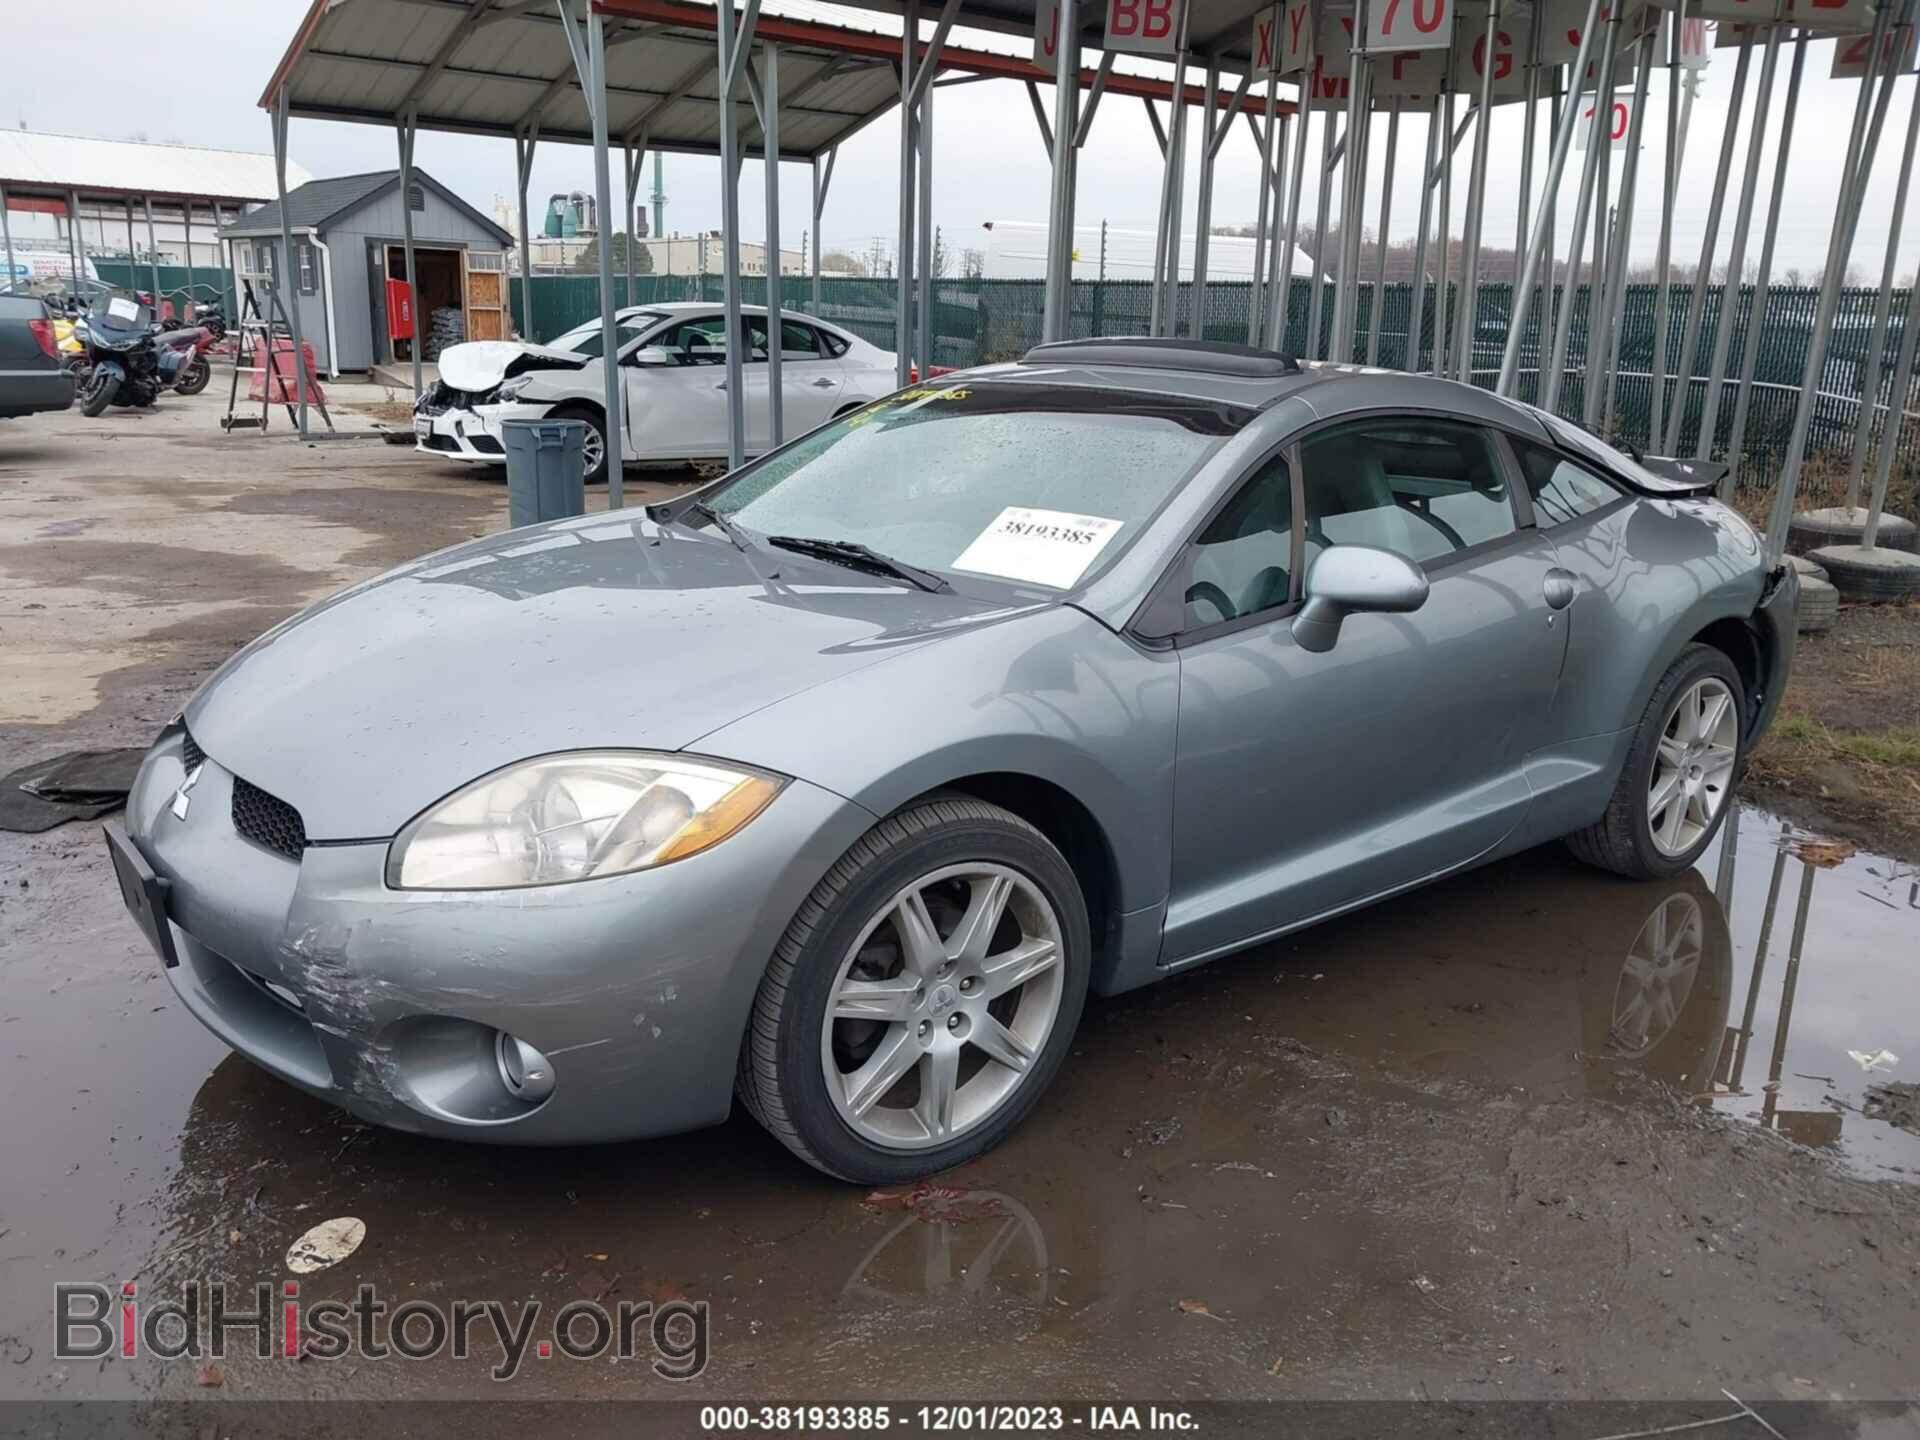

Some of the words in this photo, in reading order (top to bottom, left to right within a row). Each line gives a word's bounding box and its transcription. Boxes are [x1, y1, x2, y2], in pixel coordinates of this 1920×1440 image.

[1110, 0, 1171, 38] BB
[1291, 4, 1306, 55] Y
[1258, 20, 1272, 68] X
[1472, 29, 1512, 80] G
[997, 521, 1096, 544] 38193385
